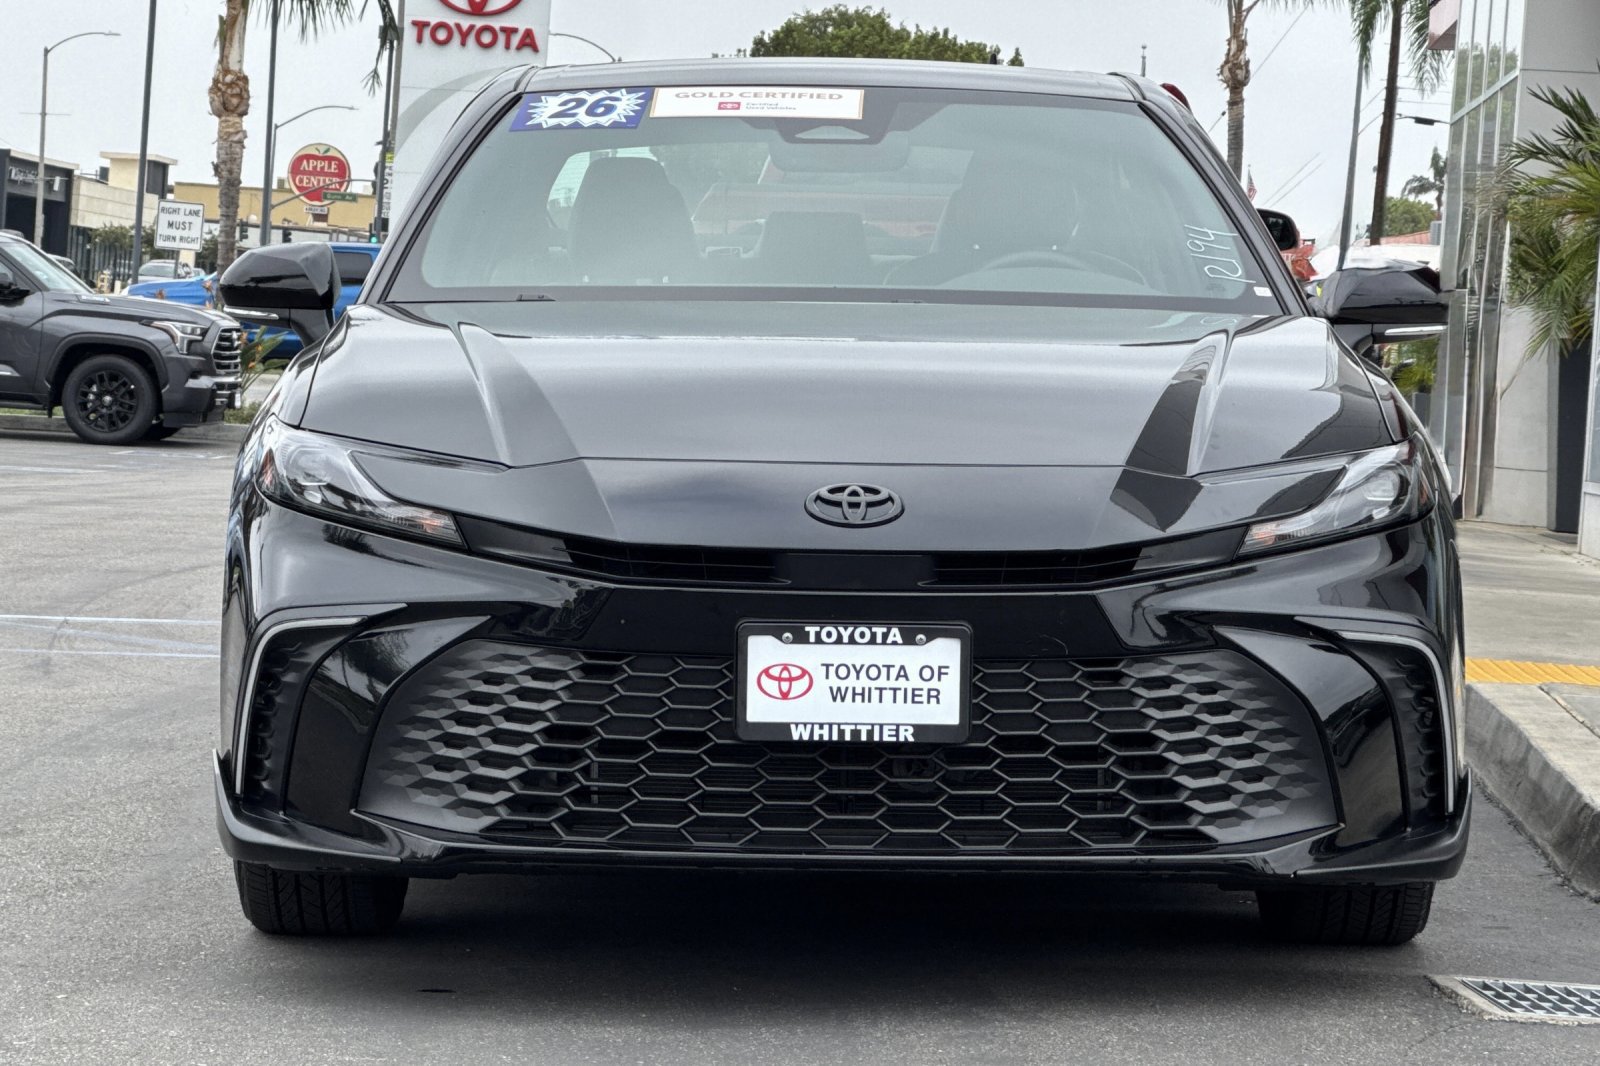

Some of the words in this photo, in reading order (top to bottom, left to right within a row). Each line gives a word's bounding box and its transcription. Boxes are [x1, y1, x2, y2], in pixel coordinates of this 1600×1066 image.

[411, 20, 540, 53] TOYOTA
[674, 91, 734, 99] GOLD
[738, 91, 844, 100] CERTIFIED
[547, 96, 622, 118] 26
[300, 159, 339, 173] APPLE
[295, 175, 340, 189] CENTER
[160, 206, 181, 215] RIGHT
[183, 208, 201, 217] LANE
[167, 220, 193, 231] MUST
[158, 234, 177, 243] TURN
[179, 235, 200, 245] RIGHT
[804, 626, 903, 644] TOYOTA
[821, 663, 910, 682] TOYOTA
[918, 664, 950, 683] OF
[828, 686, 941, 705] WHITTIER
[789, 723, 915, 742] WHITTIER
